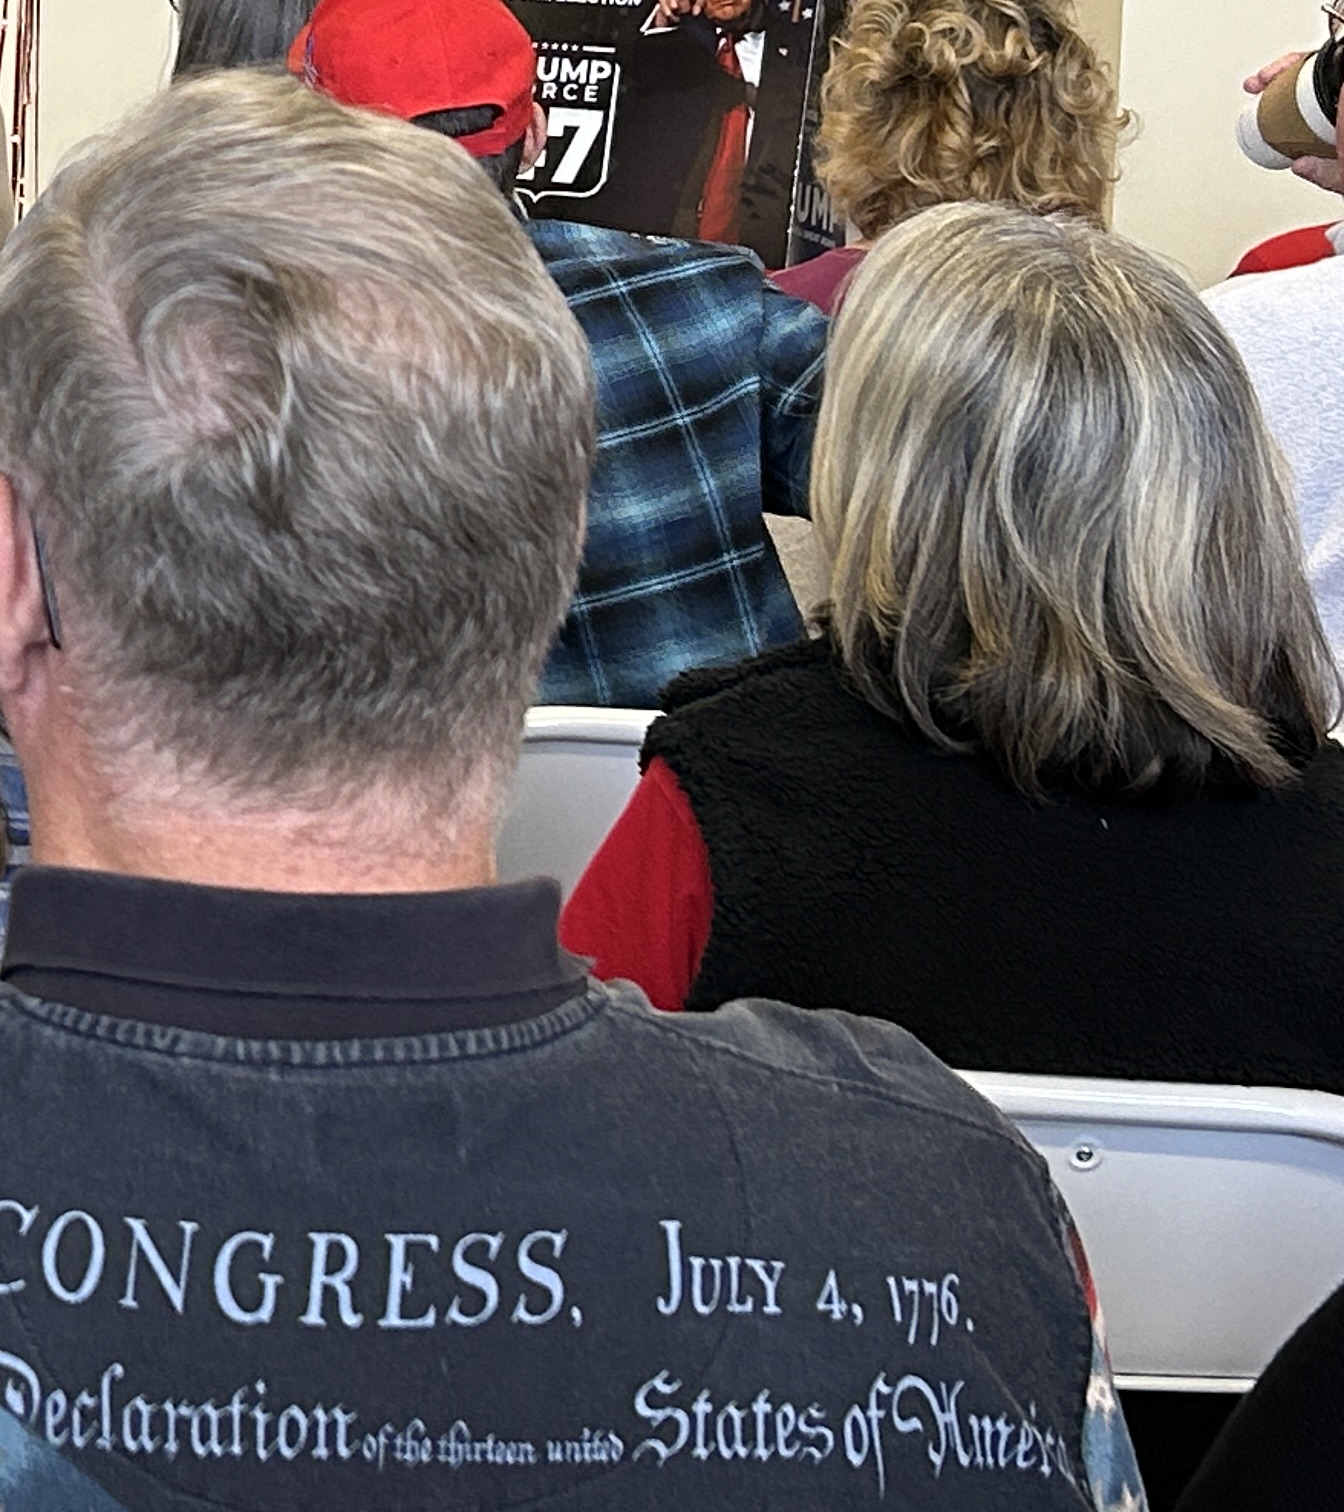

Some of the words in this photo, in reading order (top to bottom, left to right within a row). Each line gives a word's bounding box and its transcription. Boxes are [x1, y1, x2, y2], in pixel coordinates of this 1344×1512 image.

[536, 56, 612, 84] UMP
[541, 82, 599, 102] RCE
[816, 1269, 865, 1327] 4,
[888, 1272, 975, 1346] 1776.
[362, 1422, 394, 1472] of
[394, 1418, 433, 1467] the
[437, 1420, 538, 1470] thirteen
[546, 1426, 625, 1466] united
[632, 1368, 835, 1468] States
[843, 1371, 894, 1501] of
